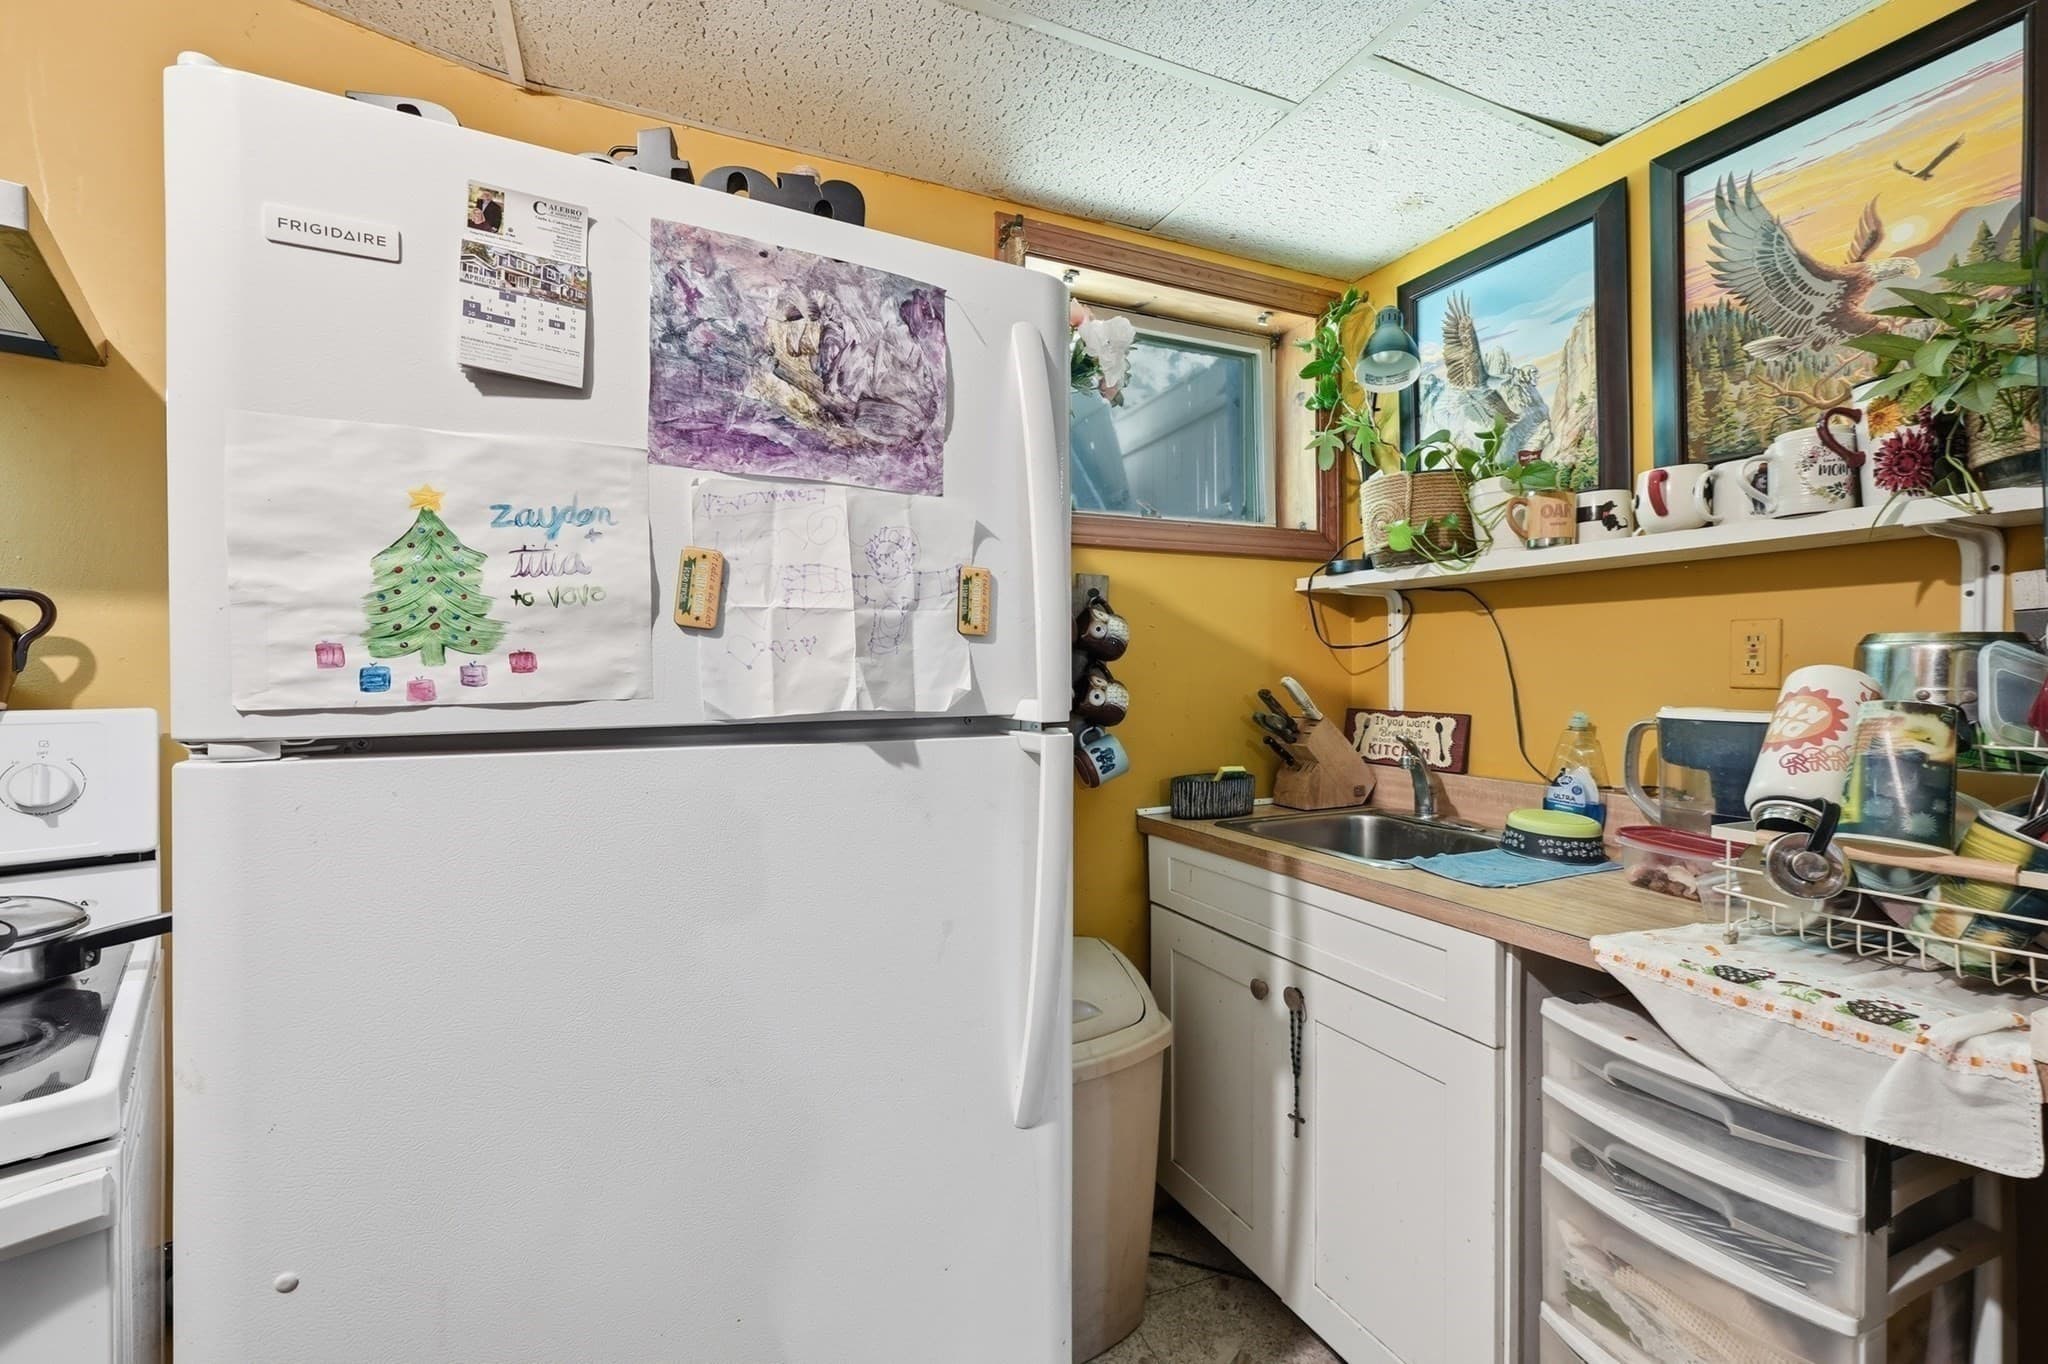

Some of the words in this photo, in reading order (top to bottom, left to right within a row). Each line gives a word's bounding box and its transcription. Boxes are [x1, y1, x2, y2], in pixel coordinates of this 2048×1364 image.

[533, 200, 582, 216] CALEBRO
[277, 217, 387, 247] FRIGIDAIRE
[510, 588, 535, 607] to
[1387, 719, 1404, 728] you
[1406, 720, 1430, 729] want
[1368, 743, 1431, 760] KITCHN
[1553, 792, 1576, 803] ULTRA
